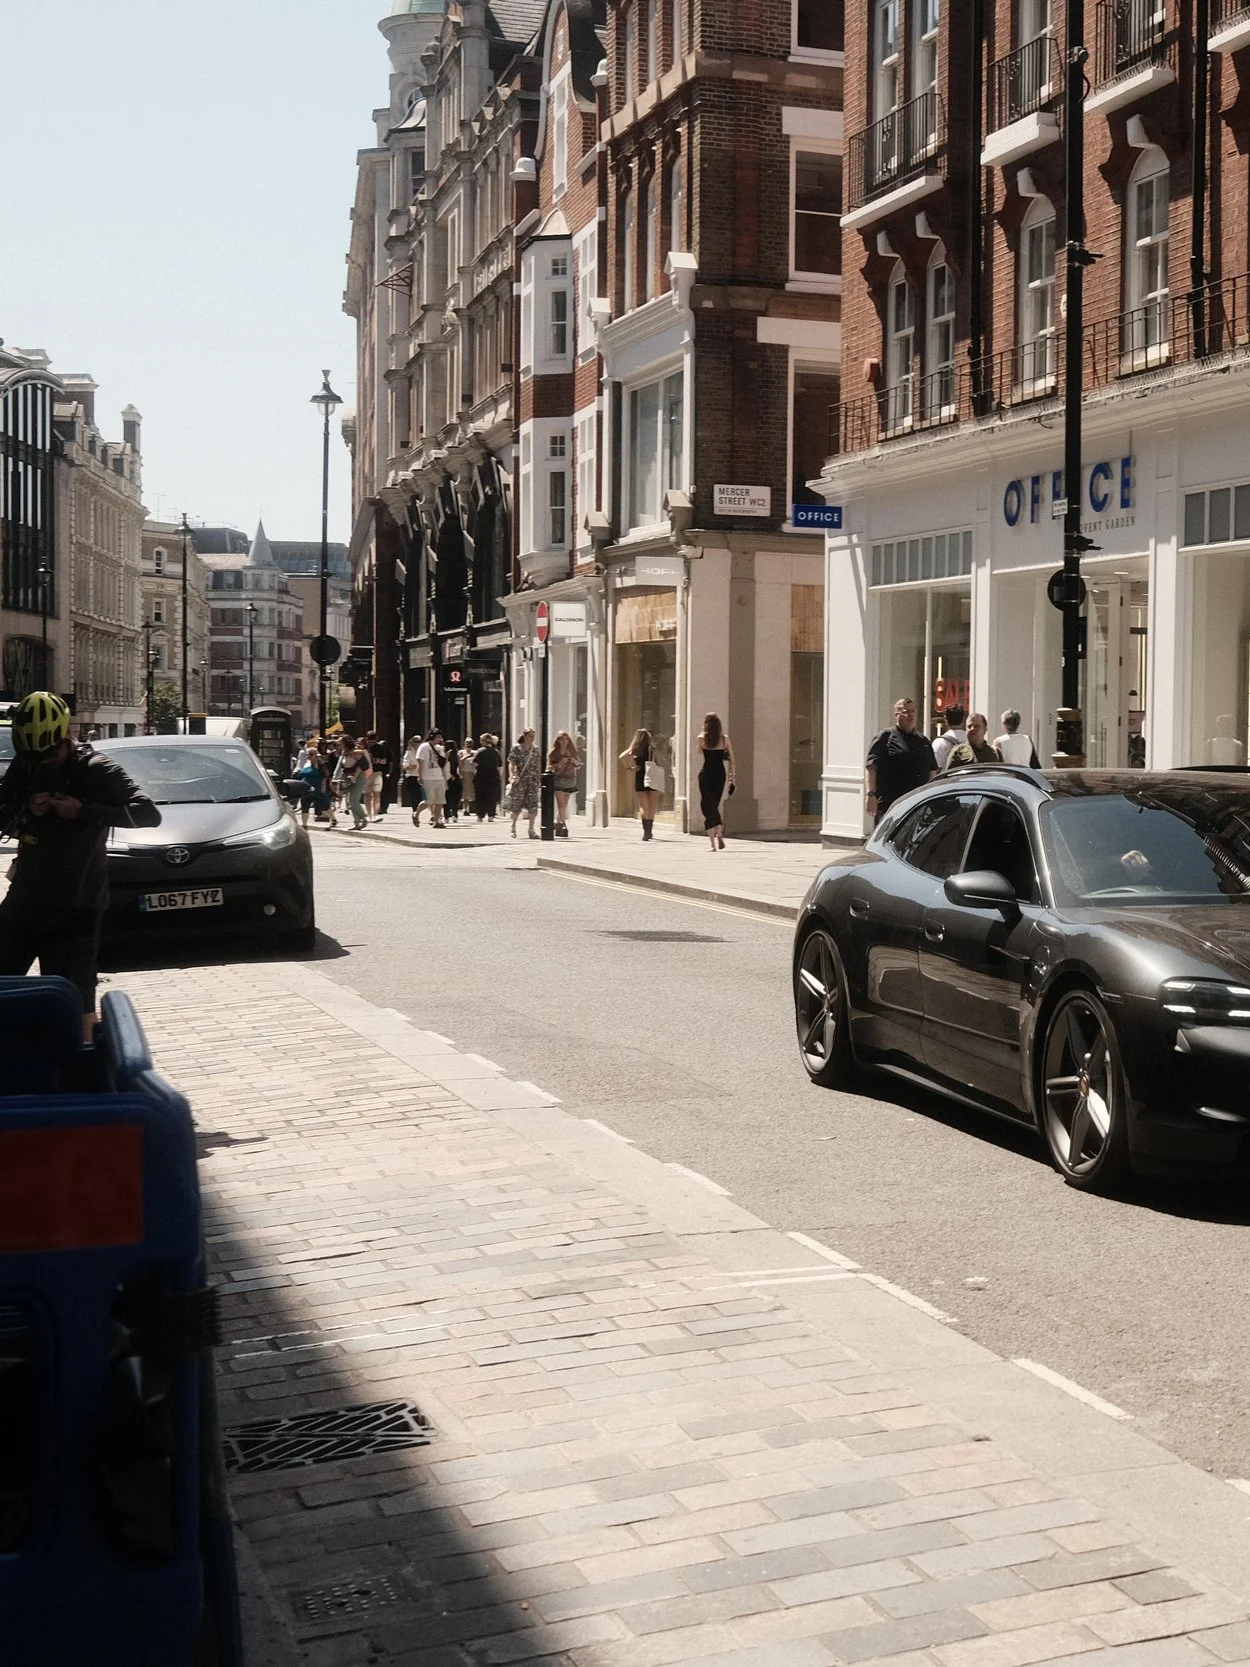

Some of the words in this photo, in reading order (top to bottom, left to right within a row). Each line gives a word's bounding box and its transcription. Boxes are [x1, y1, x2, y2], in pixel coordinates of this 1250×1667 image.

[718, 487, 750, 497] MERCER
[1003, 456, 1136, 527] OFFCE
[718, 496, 746, 506] STREET
[749, 498, 766, 507] WC2
[797, 511, 839, 522] OFFICE
[1105, 515, 1136, 530] GARDEN
[149, 893, 189, 909] LO67
[191, 889, 220, 904] FYZ
